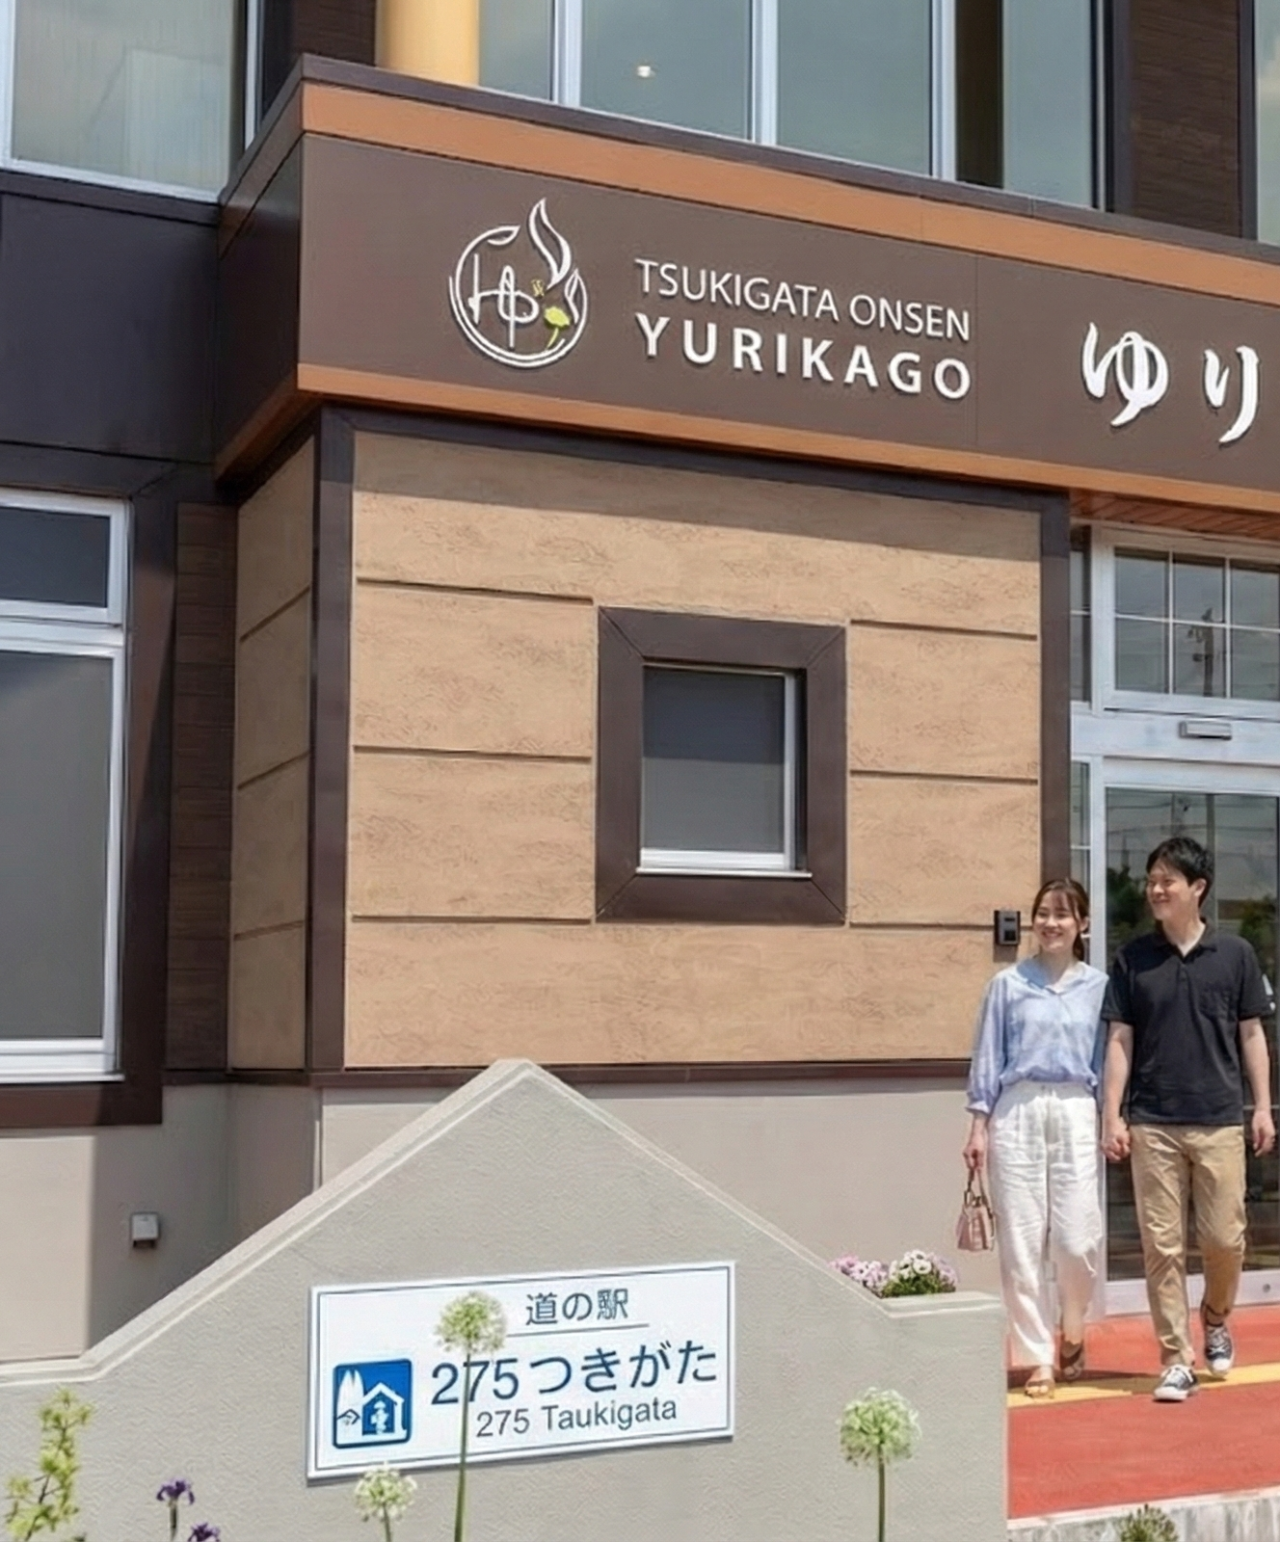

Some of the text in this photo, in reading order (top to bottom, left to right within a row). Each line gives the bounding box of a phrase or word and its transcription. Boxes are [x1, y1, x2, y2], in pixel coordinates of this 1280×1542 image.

[635, 258, 971, 341] TSUKIGATA ONSEN
[635, 312, 971, 400] YURIKAGO
[476, 1397, 677, 1437] 275 Taukigata
